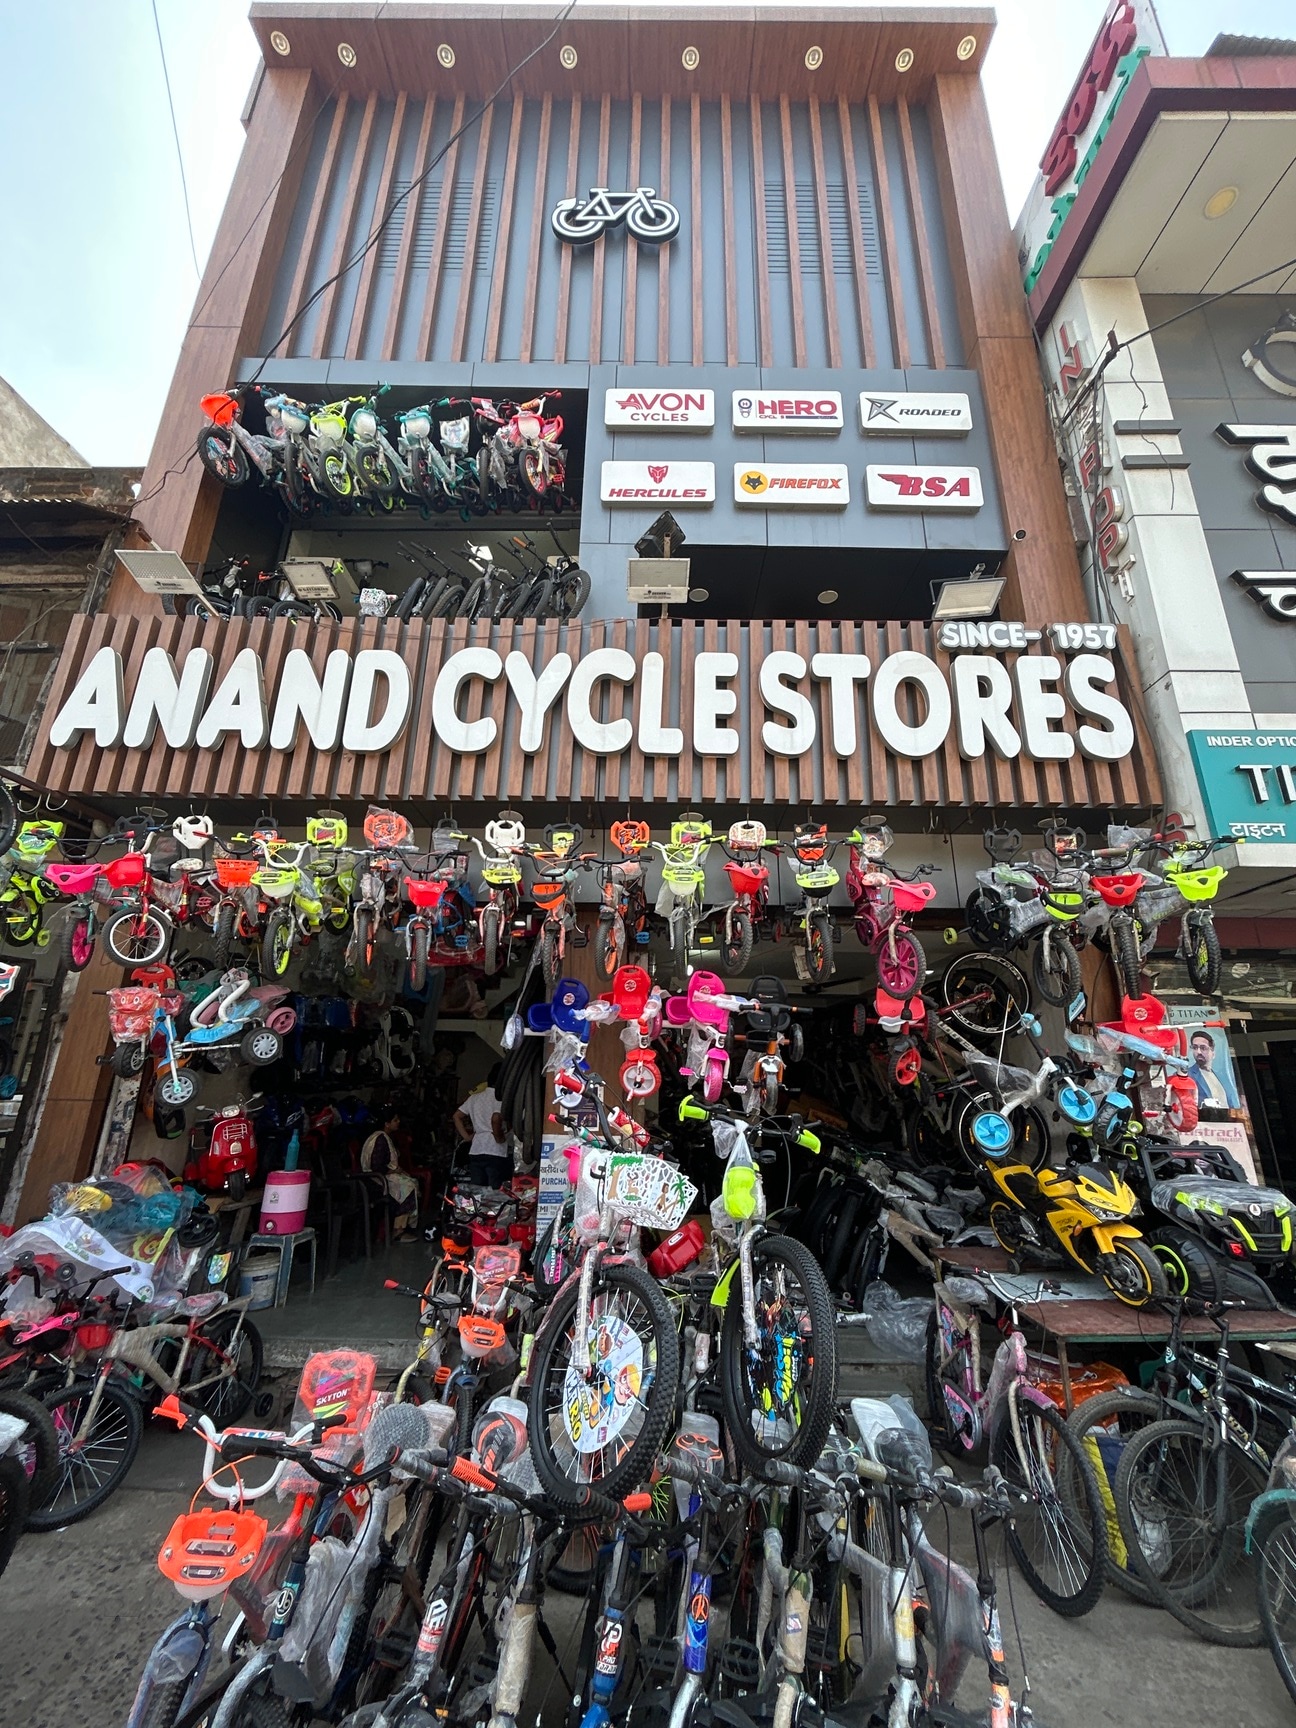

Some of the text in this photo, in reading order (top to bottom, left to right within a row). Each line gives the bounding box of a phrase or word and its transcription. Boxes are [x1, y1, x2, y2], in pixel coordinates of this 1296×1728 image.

[616, 392, 705, 412] AVON
[758, 400, 838, 416] HERO
[630, 412, 689, 422] CYCLES
[899, 407, 962, 417] ROADEO
[768, 478, 843, 490] FIREFOX
[893, 474, 971, 498] BSA
[608, 488, 708, 499] HERCULES
[1052, 623, 1116, 649] 1957
[49, 646, 1135, 762] ANAND CYCLE STORES
[1206, 735, 1253, 748] INDER
[1229, 822, 1286, 840] टाइटन
[1177, 1009, 1209, 1018] TITAN
[541, 1177, 569, 1187] PURCHA
[315, 1388, 348, 1407] SKYTON
